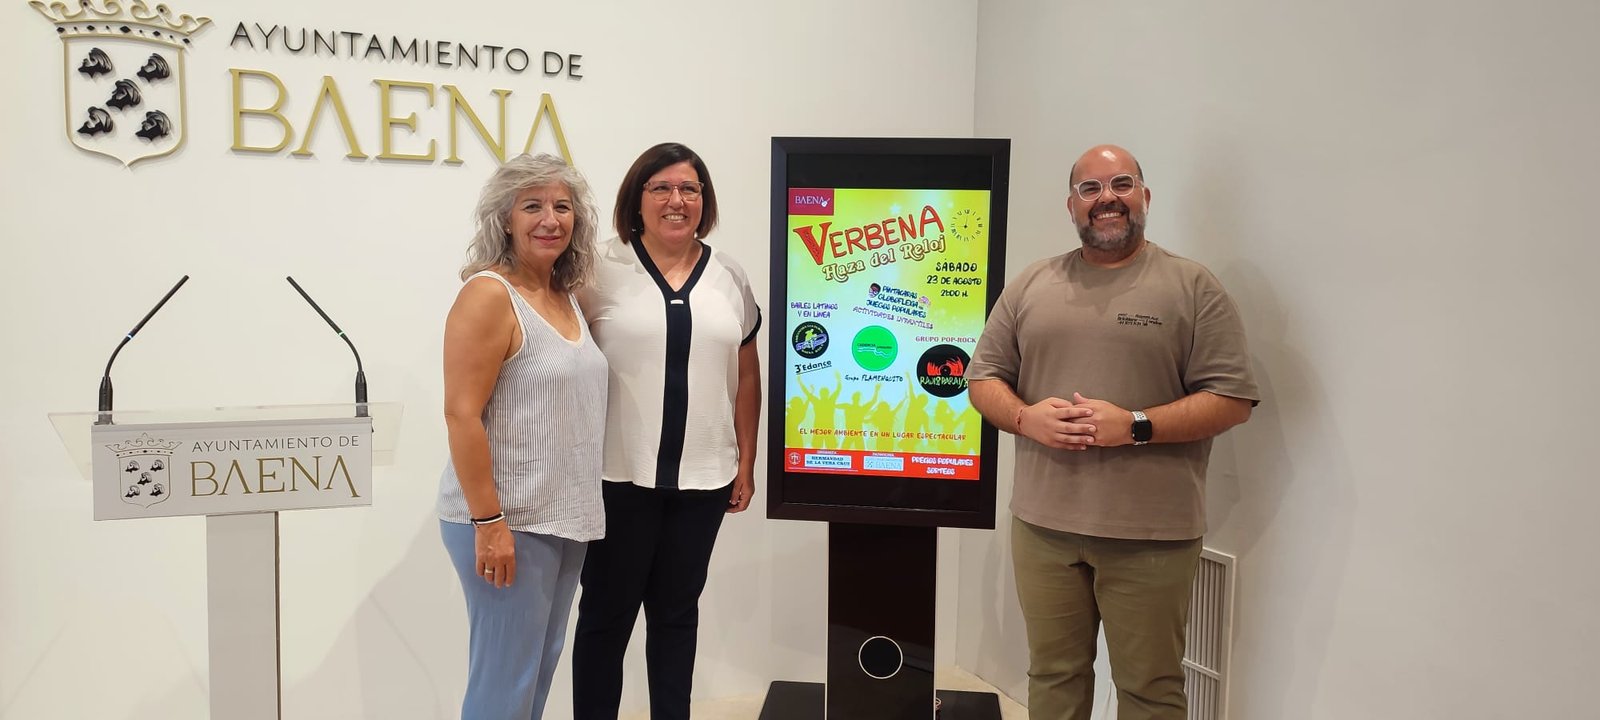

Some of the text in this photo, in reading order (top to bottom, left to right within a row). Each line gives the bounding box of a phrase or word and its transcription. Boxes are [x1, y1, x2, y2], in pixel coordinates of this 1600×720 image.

[229, 21, 583, 78] AYUNTAMIENTO DE
[228, 67, 577, 167] BAENA
[795, 195, 823, 205] BAENA
[792, 204, 944, 265] VERBENA
[822, 234, 946, 283] Haza del Reloj
[936, 258, 977, 272] SÁBADO
[927, 275, 982, 285] 23 DE AGOSTO
[883, 286, 918, 299] PINTACARAS
[813, 302, 838, 310] LATINOS
[878, 294, 919, 308] GLOBOFLEXIA
[852, 306, 894, 320] ACTIVIDADES
[866, 299, 927, 318] JUEGOS POPULARES
[834, 429, 868, 437] AMBIENTE
[917, 432, 966, 440] ESPECTACULAR
[192, 436, 359, 453] AYUNTAMIENTO DE
[911, 456, 936, 464] PRECIOS
[937, 457, 973, 466] POPULARES
[190, 455, 361, 498] BAENA
